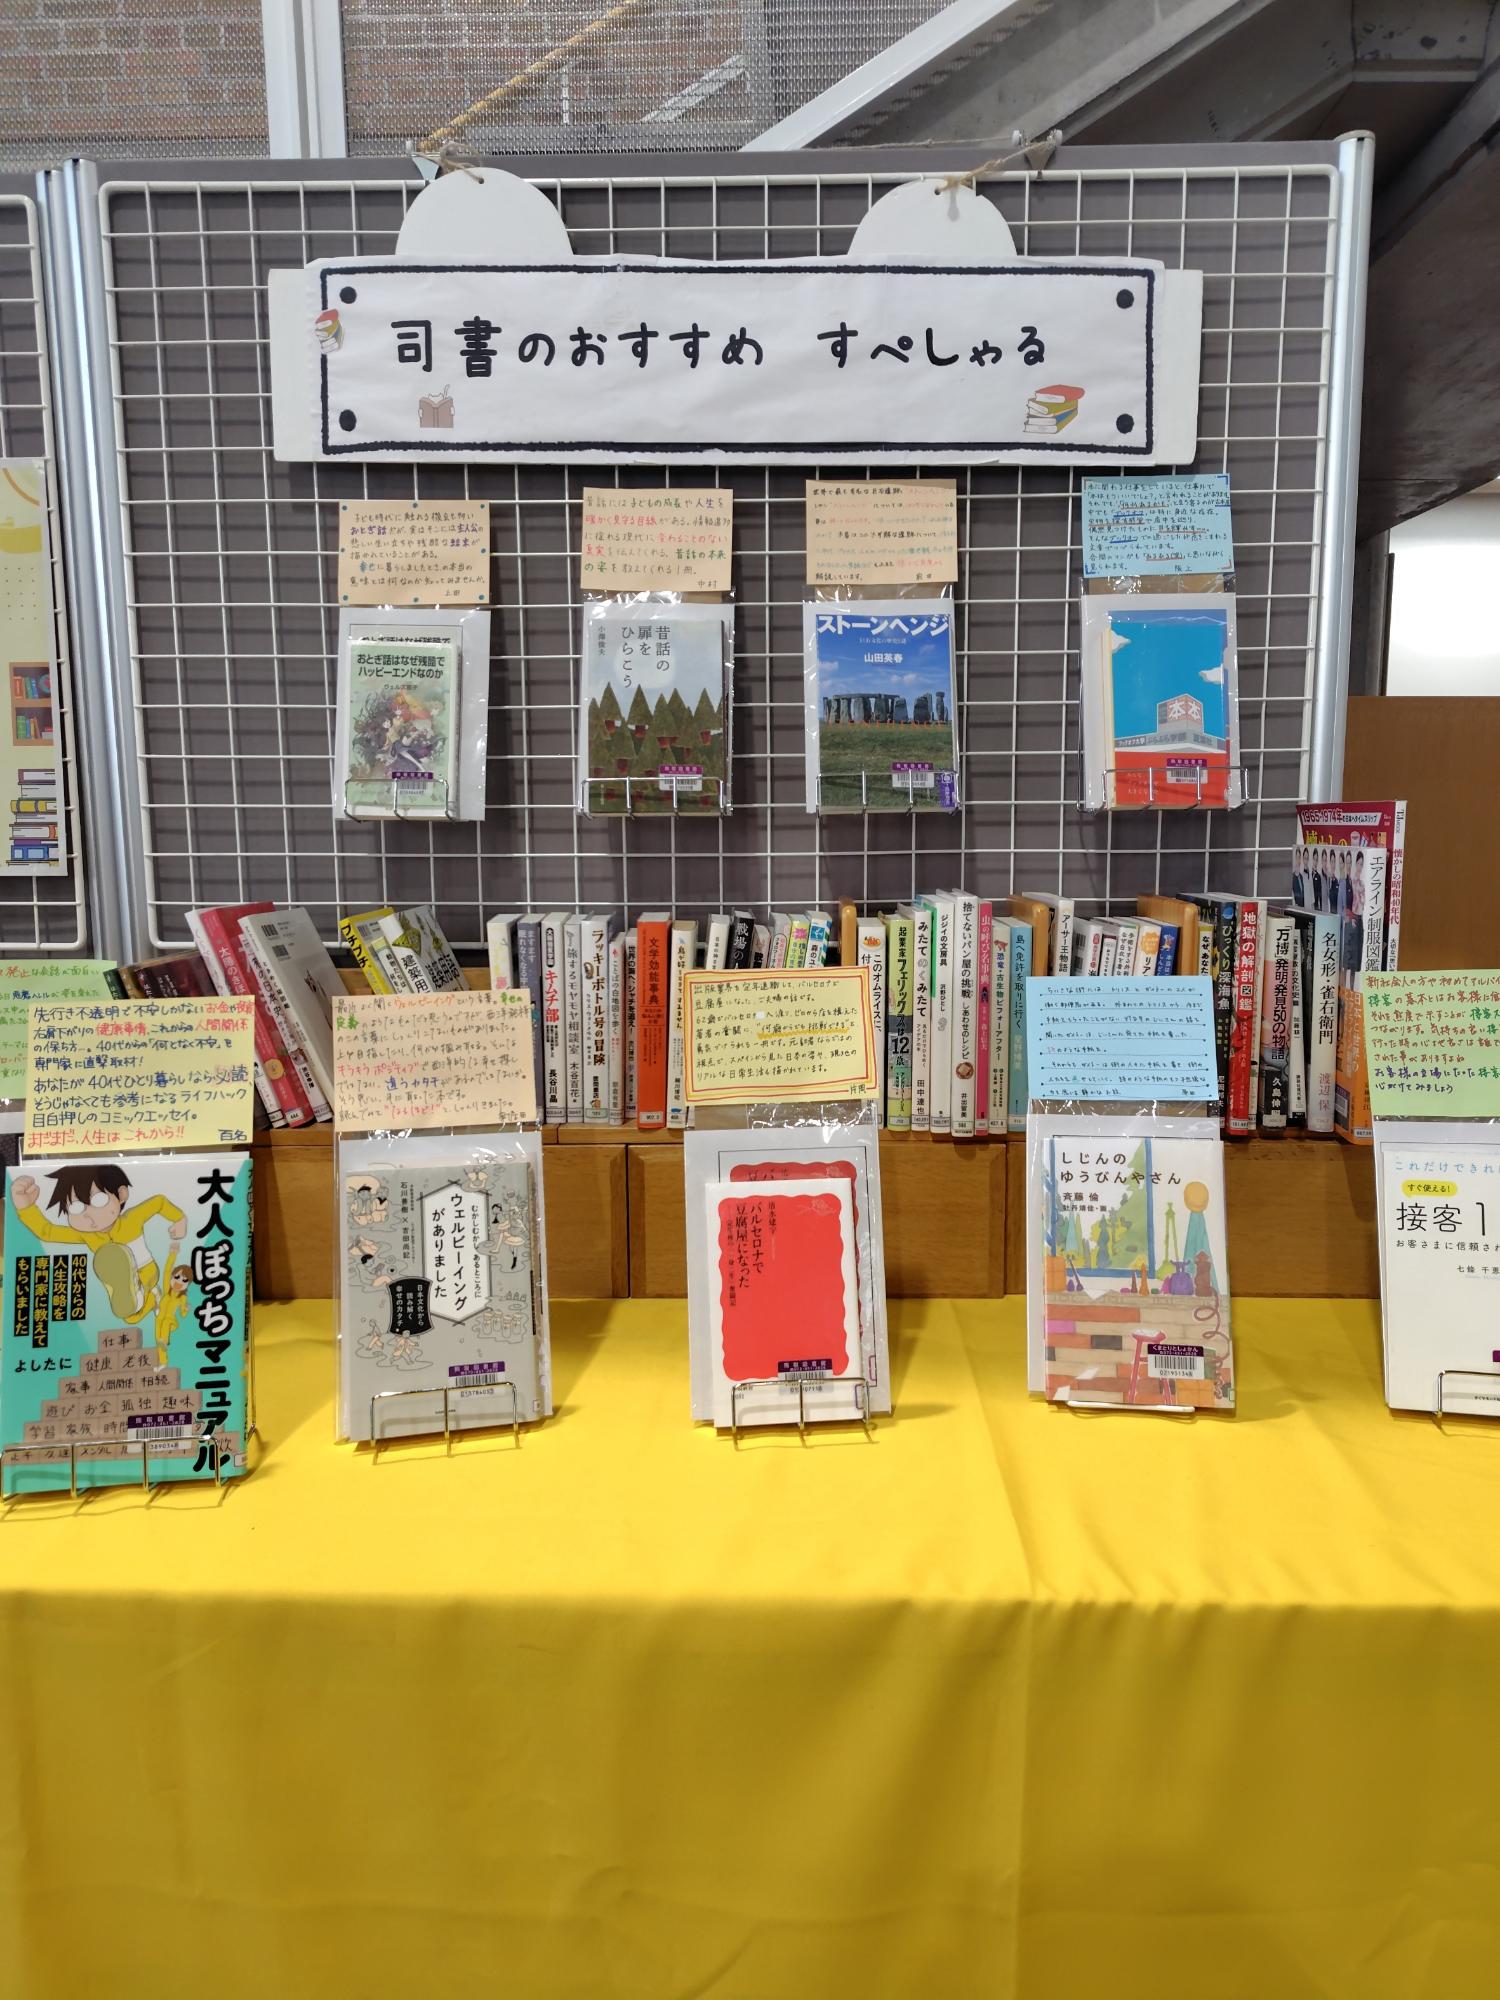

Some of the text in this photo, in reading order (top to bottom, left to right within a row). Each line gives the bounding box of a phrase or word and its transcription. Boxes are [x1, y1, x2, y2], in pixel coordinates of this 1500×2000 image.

[392, 314, 1047, 379] 司書のおすすめ すぺしゃる
[638, 625, 652, 656] 扉を
[656, 625, 670, 672] 昔話の
[817, 615, 949, 636] ストーンヘンジ
[357, 654, 446, 668] おとぎ話はなぜ残酷で
[358, 668, 443, 679] ハッピーエンドなのか
[622, 626, 634, 688] ひらこう
[864, 653, 903, 664] 山田英春
[1365, 856, 1385, 972] エアライン制服図鑑
[861, 955, 872, 965] 付
[939, 915, 948, 966] ジジイの文房具
[981, 916, 990, 985] 虫の呼び名事典
[1058, 914, 1071, 973] アーサー王物語
[1239, 911, 1257, 1011] 地獄の解剖図鑑
[648, 938, 661, 1005] 文学効能事典
[872, 954, 883, 1033] このオムライスに、
[916, 922, 929, 1017] みたてのくみたて
[961, 902, 973, 1060] 捨てないパン屋の挑戦 しあわせのレシピ
[1015, 935, 1025, 1029] 島へ免許を取りに行く
[1271, 925, 1293, 1060] 「万博」発明発見50の物語
[1318, 931, 1337, 1045] 名女形・雀右衛門
[545, 969, 560, 1023] キムチ部
[567, 947, 580, 1055] 旅するモヤモヤ相談室
[592, 930, 606, 1066] ラッキーボトル号の冒険
[996, 952, 1006, 1061] 恐竜・古生物ビフォーアフター
[549, 1069, 558, 1104] 長谷川晶
[850, 1084, 867, 1095] 片岡
[917, 1079, 925, 1114] 田中達也
[32, 1109, 198, 1128] 目白押しのコミックエッセイ。
[218, 1129, 248, 1141] 百名
[1059, 1171, 1182, 1185] ゆうびんやさん
[1061, 1151, 1127, 1165] しじんの
[1394, 1161, 1500, 1173] これだけできれ
[1089, 1192, 1099, 1202] 倫
[1406, 1183, 1451, 1193] すぐ使える!
[431, 1208, 448, 1299] がありました
[449, 1193, 467, 1312] ウェルビーイング
[735, 1202, 750, 1289] 豆腐屋になった
[750, 1202, 764, 1274] バルセロナで
[15, 1257, 30, 1336] もらいました
[33, 1256, 48, 1348] 専門家に教えて
[53, 1256, 67, 1320] 人生攻略を
[71, 1256, 87, 1319] 40代からの
[395, 1284, 404, 1327] 幸せのカタチ
[417, 1284, 425, 1326] 日本文化から
[103, 1333, 131, 1348] 仕事
[192, 1168, 235, 1474] 大人ぼっちマニュアル
[14, 1358, 72, 1373] よしたに
[65, 1375, 169, 1394] 家事 人間関係 相続
[86, 1354, 152, 1372] 健康 老後
[30, 1425, 55, 1440] 学習
[66, 1423, 92, 1436] 家族
[46, 1396, 195, 1418] 遊び お金 孤独 趣味
